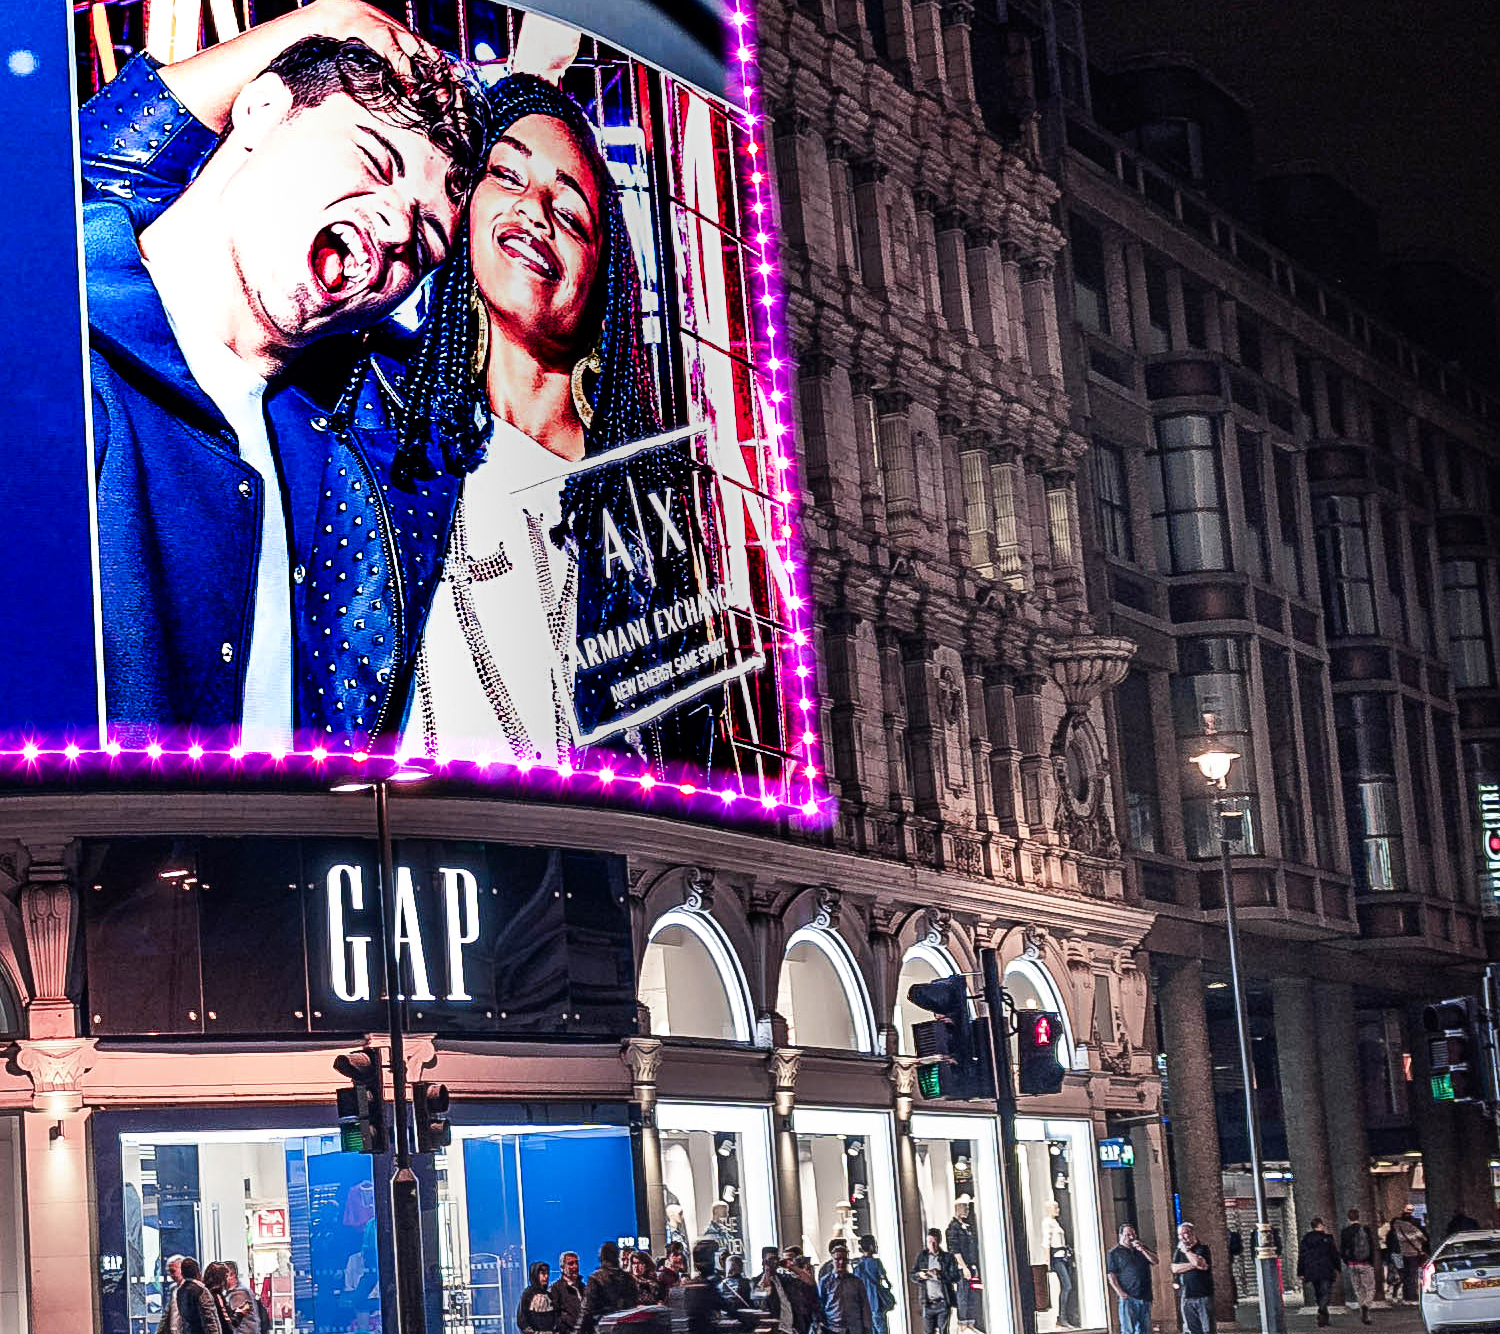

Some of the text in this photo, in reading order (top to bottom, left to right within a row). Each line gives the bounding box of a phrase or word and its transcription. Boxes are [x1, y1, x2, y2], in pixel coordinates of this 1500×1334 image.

[575, 584, 731, 671] ARMANI EXCHANG
[610, 677, 637, 703] NEW
[326, 864, 481, 1003] GAP
